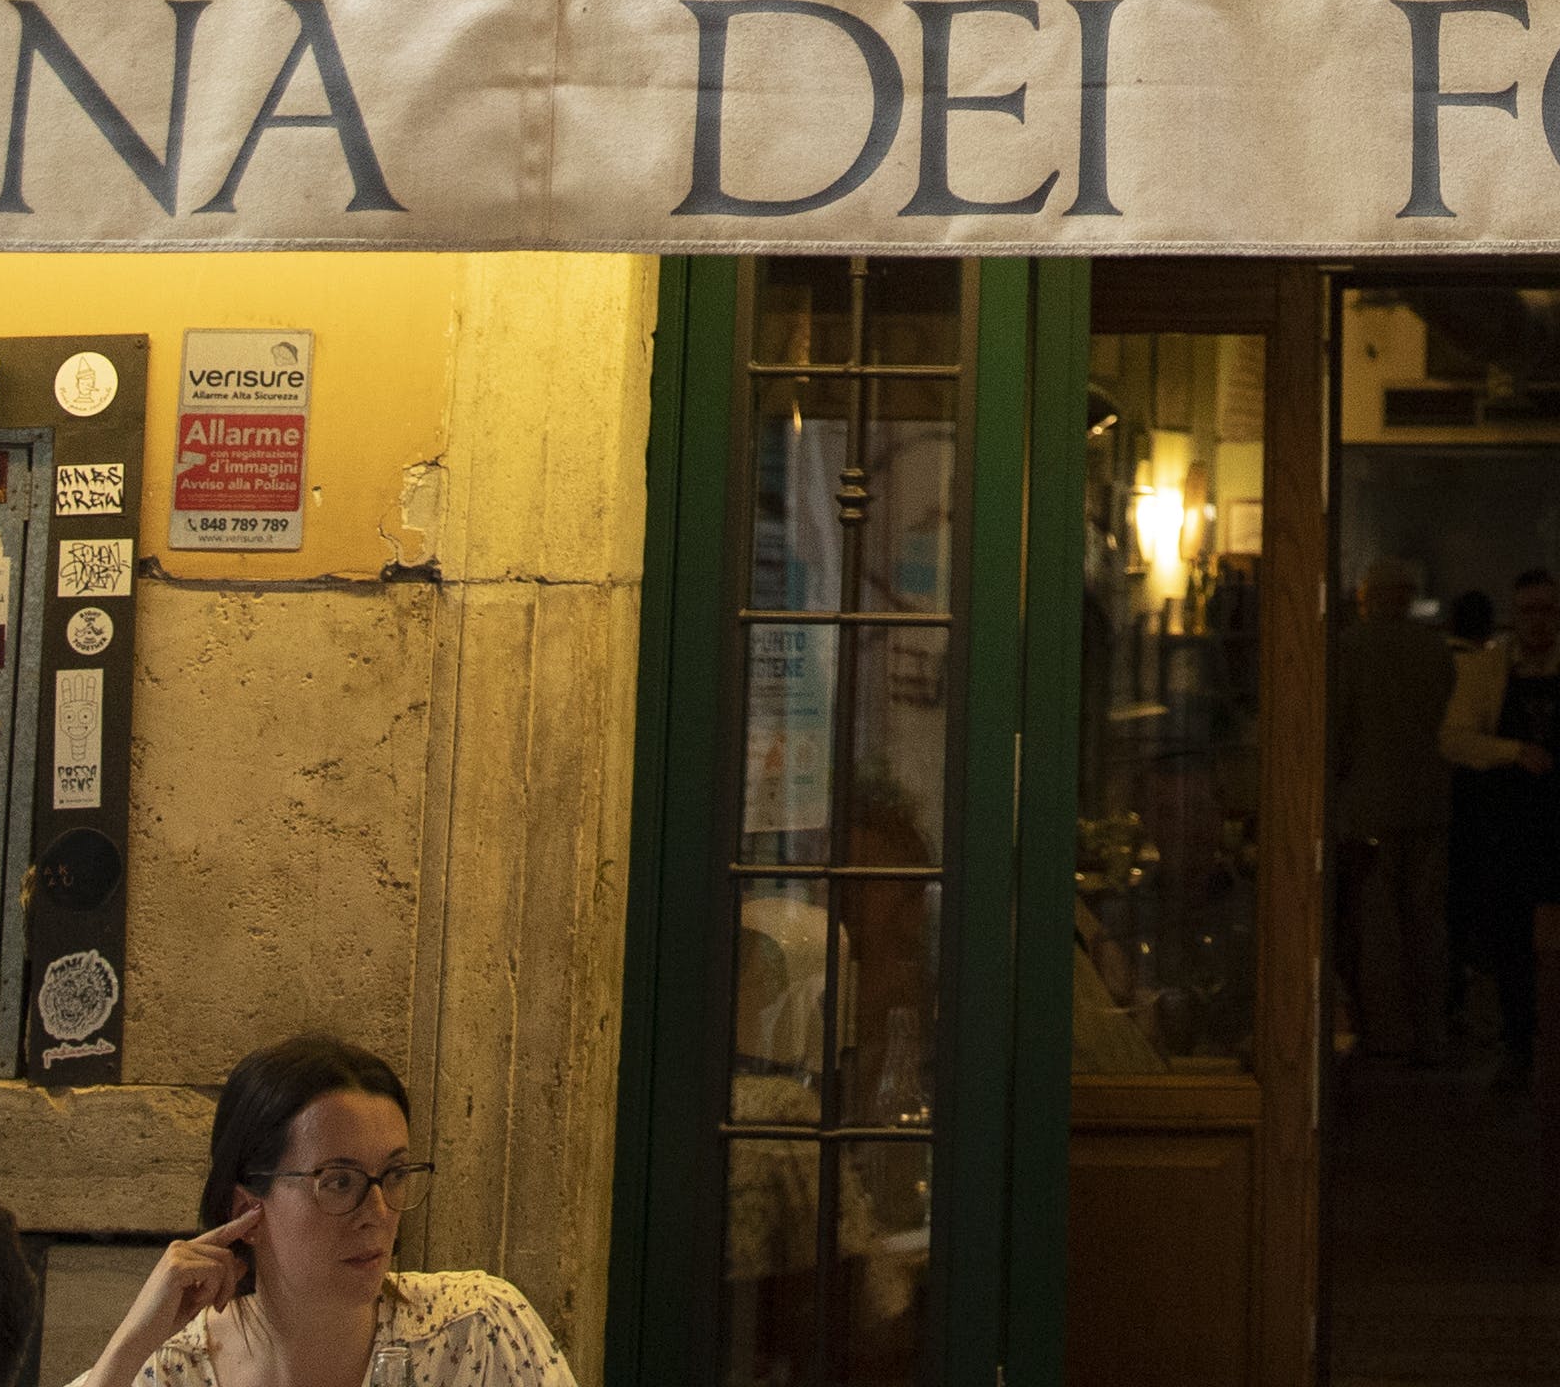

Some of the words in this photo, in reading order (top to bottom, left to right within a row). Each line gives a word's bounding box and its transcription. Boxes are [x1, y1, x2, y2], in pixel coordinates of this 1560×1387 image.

[189, 369, 305, 389] verisure
[192, 391, 228, 400] Allarme
[231, 391, 252, 400] Alta
[254, 391, 299, 401] Sicurezza
[185, 418, 301, 447] Allarme
[181, 478, 225, 490] Avviso
[228, 478, 251, 491] alla
[254, 478, 298, 491] Polizia
[200, 518, 228, 532] 848
[231, 518, 259, 532] 789
[262, 518, 290, 532] 789
